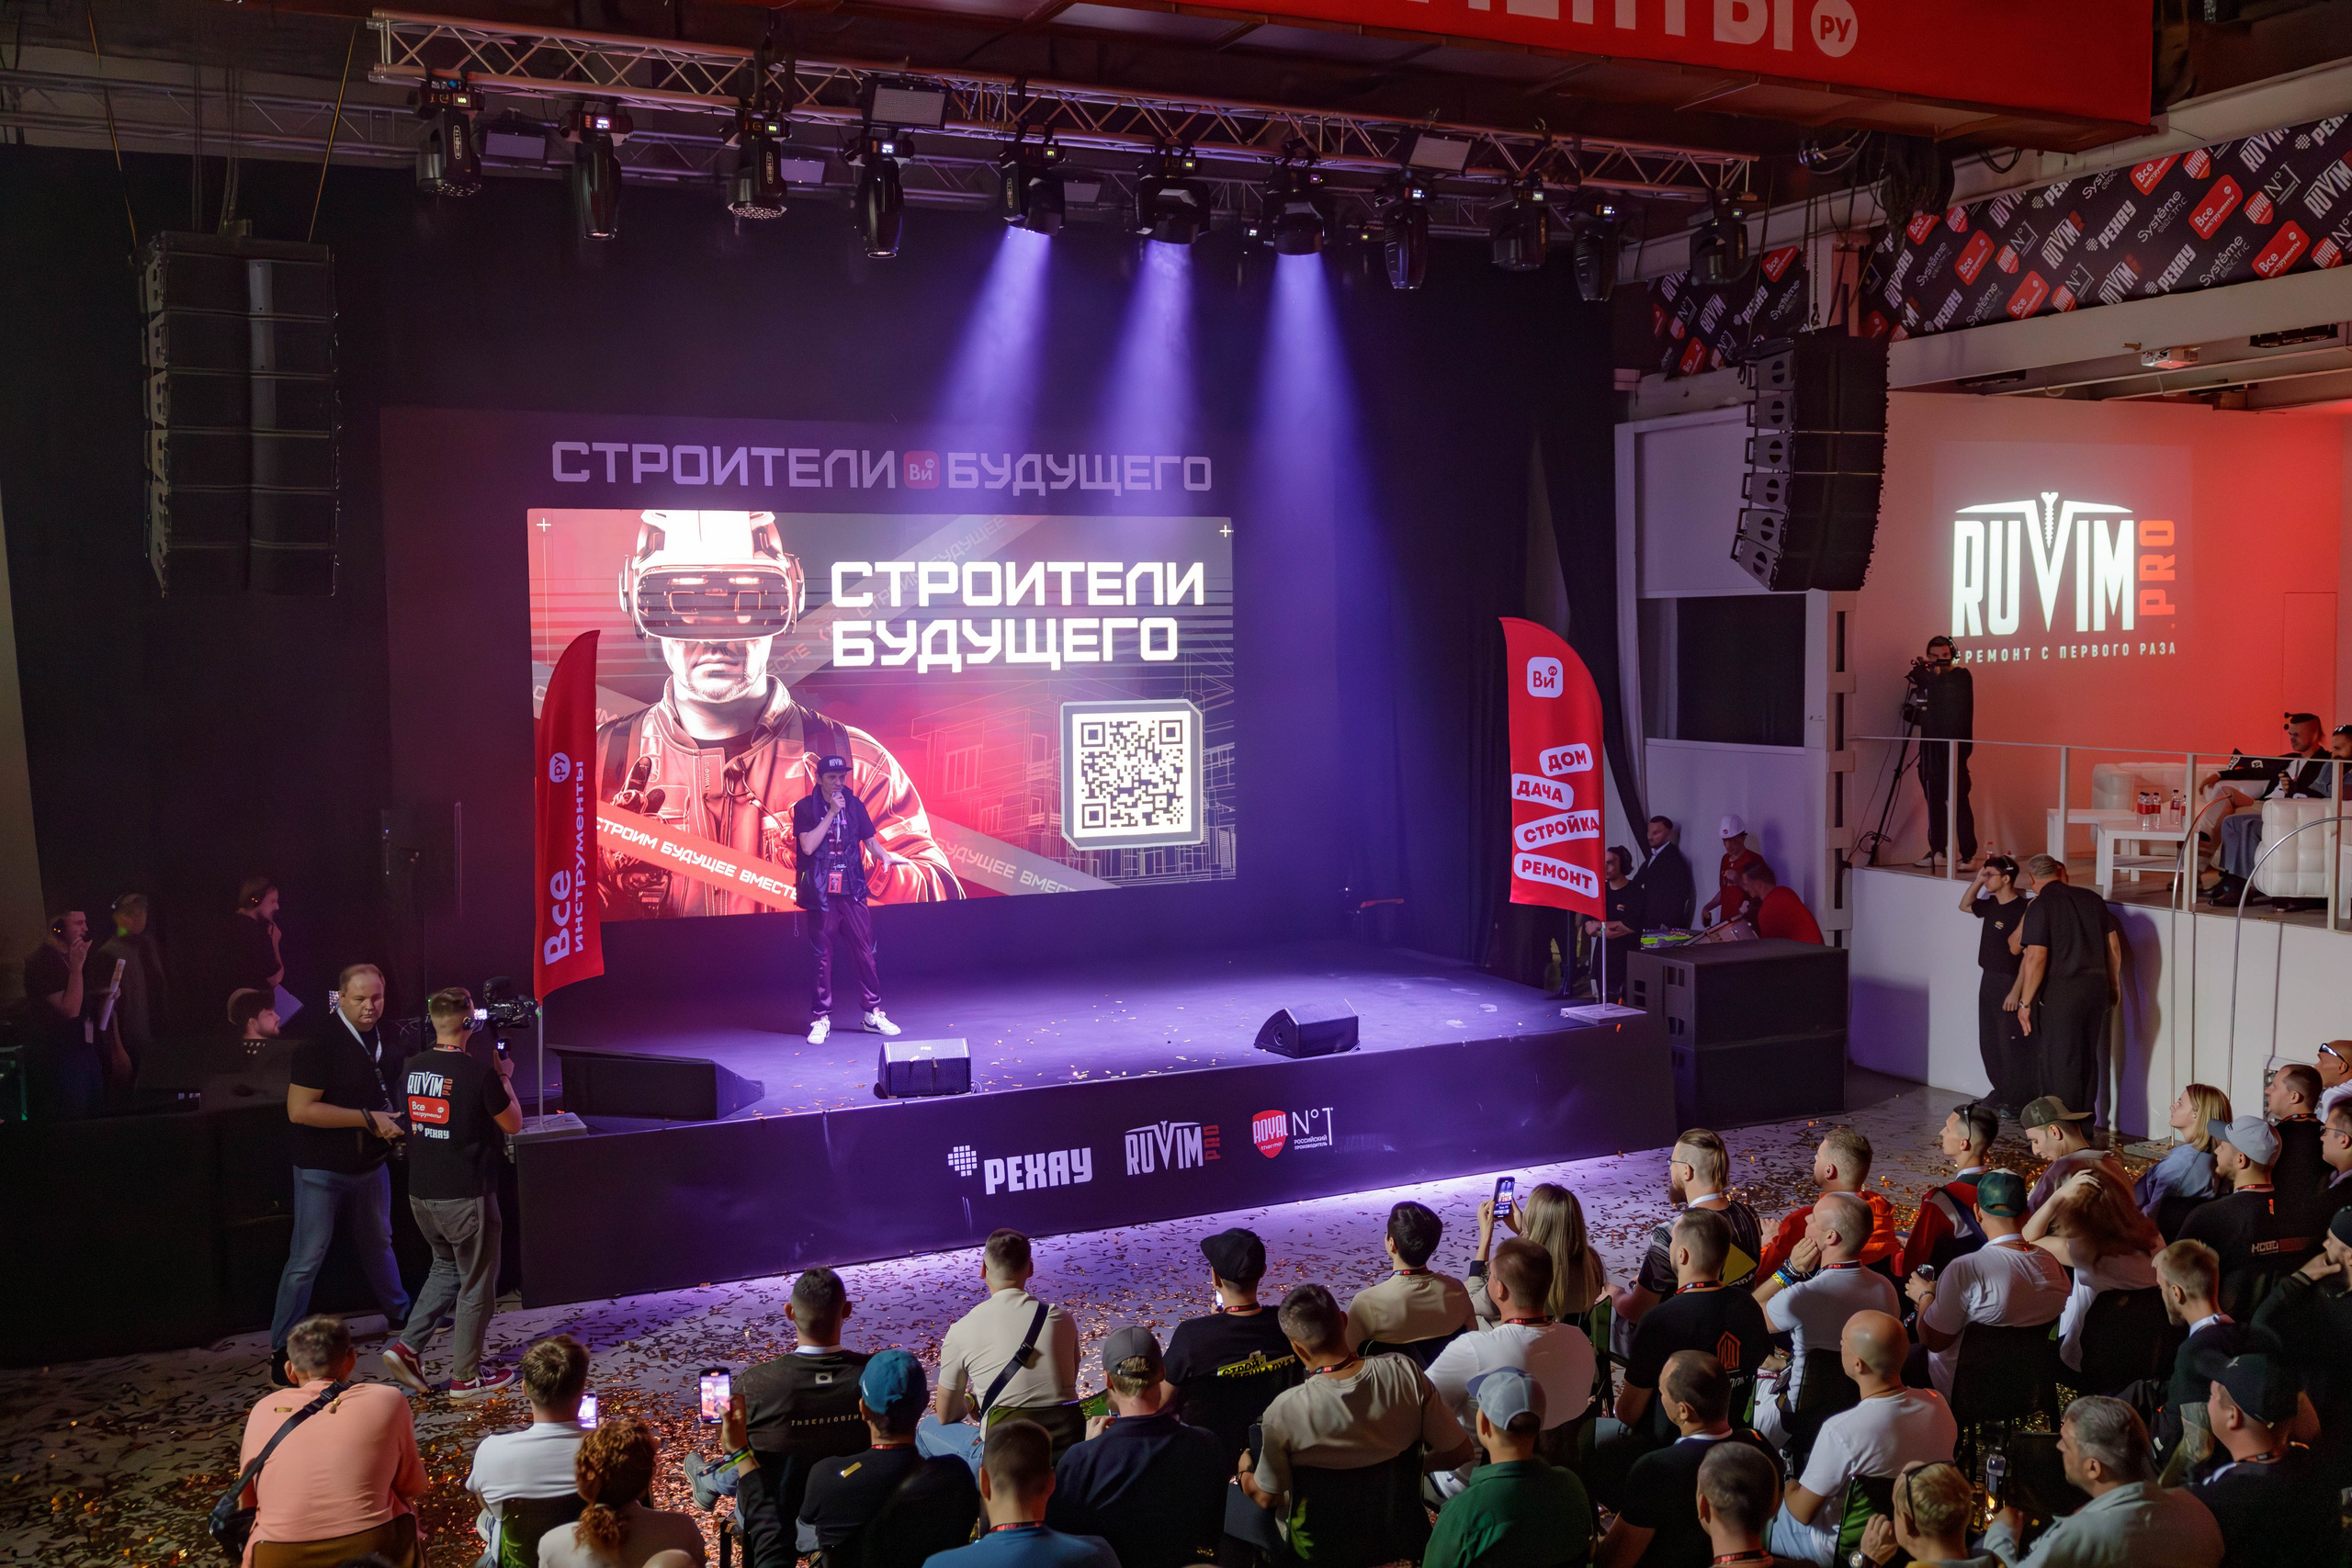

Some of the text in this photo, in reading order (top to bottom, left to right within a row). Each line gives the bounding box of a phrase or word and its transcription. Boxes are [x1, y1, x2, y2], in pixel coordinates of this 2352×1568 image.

[2135, 163, 2154, 184] Все
[2098, 199, 2137, 250] РЕХАУ
[2194, 207, 2214, 227] Все
[2041, 218, 2081, 270] RUVIM
[1959, 257, 1973, 275] Все
[2156, 243, 2197, 292] РЕХАУ
[2258, 253, 2279, 274] Все
[2012, 297, 2028, 316] Все
[551, 442, 896, 489] СТРОИТЕЛИ
[947, 452, 1212, 496] БУДУЩЕГО
[1951, 491, 2134, 637] RUVIM
[831, 561, 1204, 607] СТРОИТЕЛИ
[831, 617, 1179, 674] БУДУЩЕГО
[2059, 644, 2129, 659] ПЕРВОГО
[2140, 642, 2176, 656] РАЗА
[1548, 750, 1587, 772] ДОМ
[1516, 780, 1563, 803] ДАЧА
[1523, 815, 1600, 843] СТРОЙКА
[574, 761, 586, 953] инструменты
[660, 841, 737, 879] БУДУЩЕЕ
[1521, 859, 1592, 890] РЕМОНТ
[544, 870, 571, 965] Все
[407, 1071, 445, 1097] RUVIM
[412, 1100, 425, 1111] Все
[424, 1127, 450, 1139] РЕХАУ
[1253, 1113, 1288, 1144] ROYAL
[1294, 1134, 1328, 1145] РОССИЙСКИЙ
[1125, 1120, 1204, 1175] RUVIM
[1261, 1142, 1283, 1151] thermo
[984, 1147, 1092, 1194] РЕХАУ
